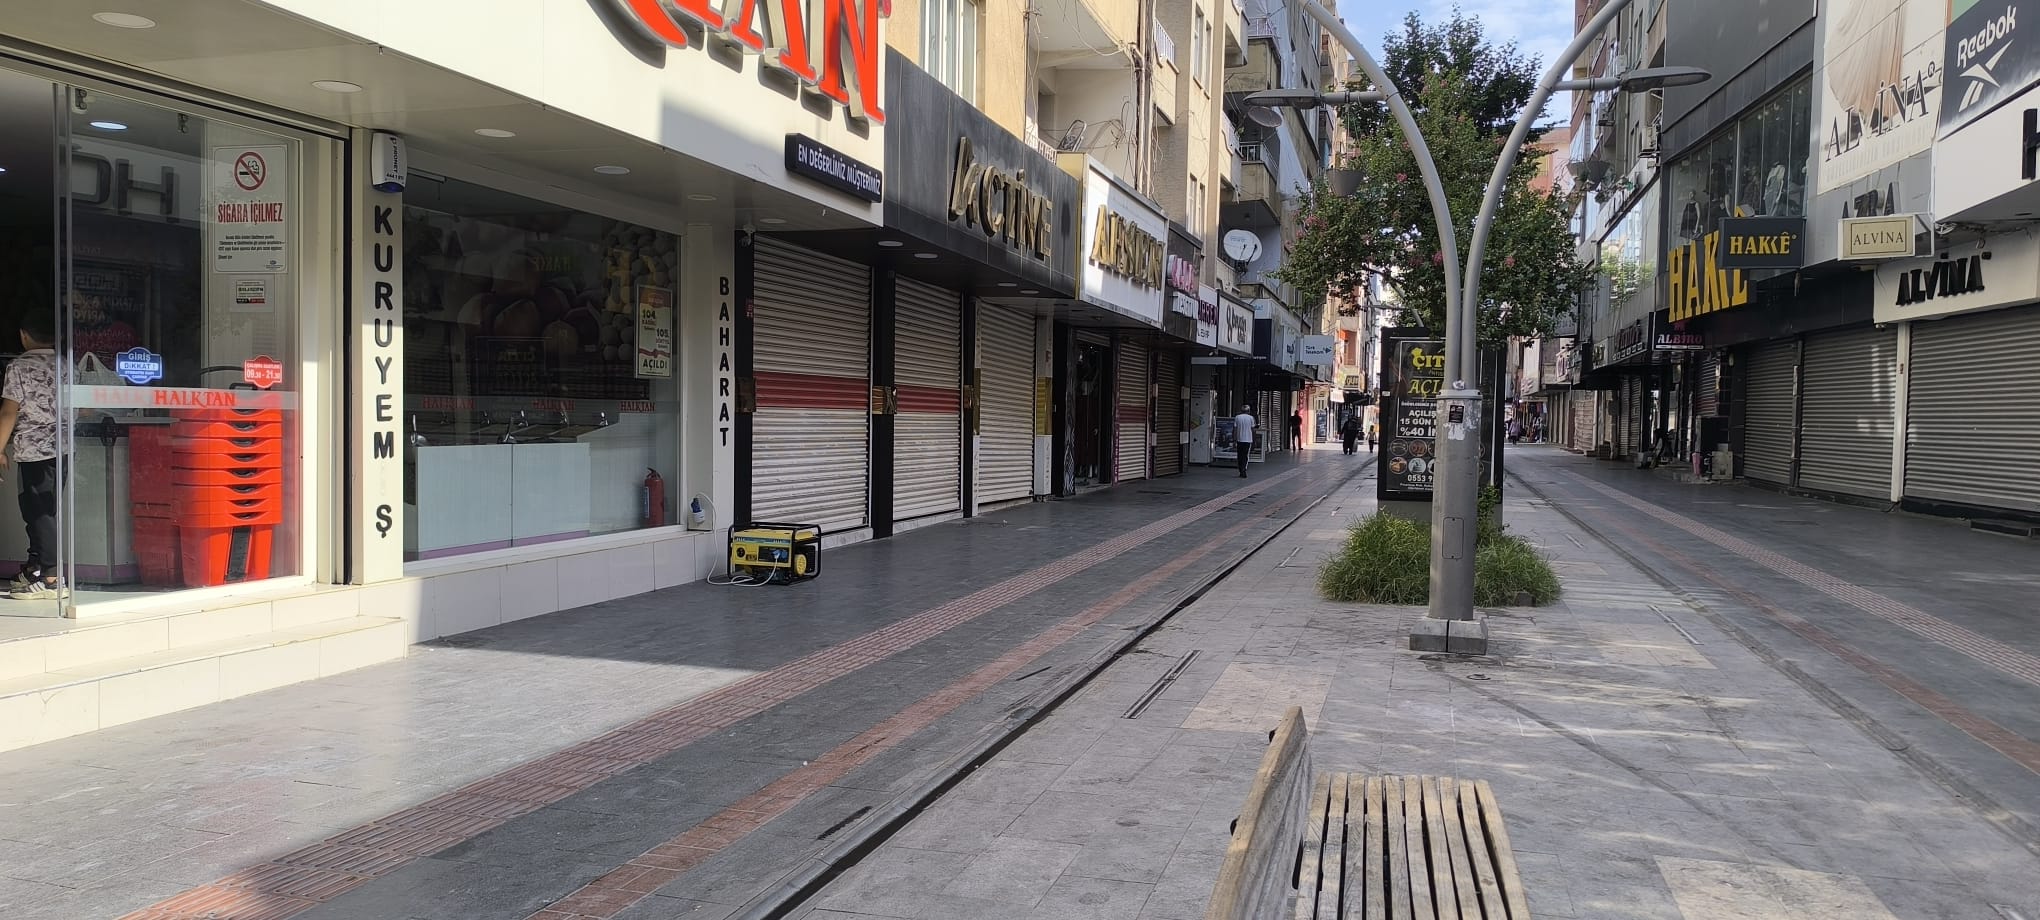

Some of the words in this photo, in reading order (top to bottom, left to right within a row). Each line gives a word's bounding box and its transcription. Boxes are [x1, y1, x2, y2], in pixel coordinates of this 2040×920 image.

[1957, 5, 2017, 68] Reebok
[798, 143, 808, 164] EN
[809, 147, 846, 180] DEĞERLİMİZ
[846, 164, 881, 195] MÜŞTERİMİZ
[218, 201, 249, 223] SİGARA
[250, 199, 284, 225] İÇİLMEZ
[1853, 229, 1905, 246] ALVİNA
[1896, 252, 1985, 306] ALVİNA
[128, 352, 151, 362] GİRİŞ
[718, 276, 730, 448] BAHARAT
[154, 389, 237, 408] HALKTAN
[1400, 427, 1424, 436] %40
